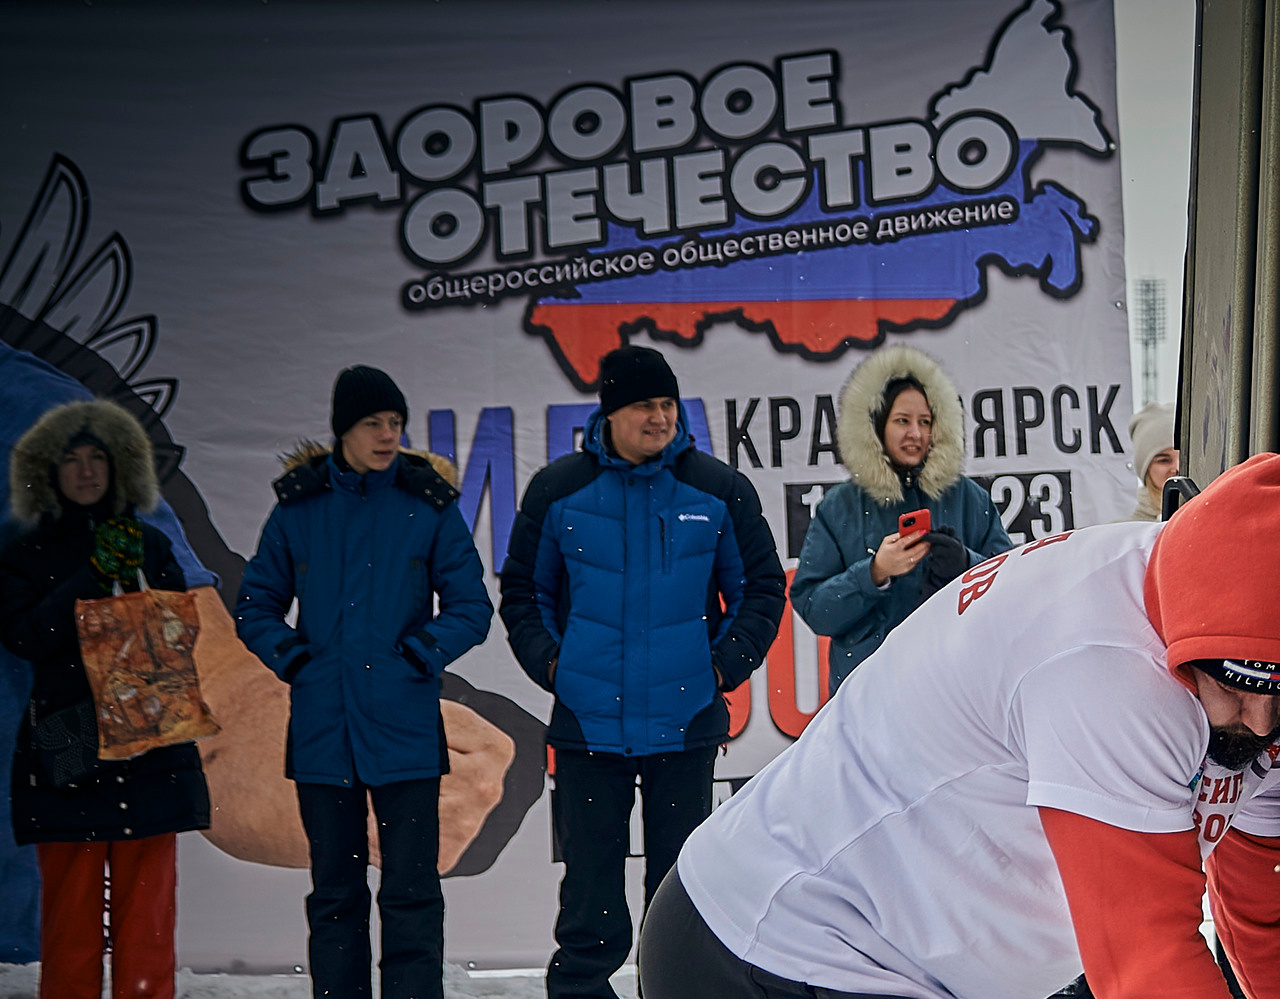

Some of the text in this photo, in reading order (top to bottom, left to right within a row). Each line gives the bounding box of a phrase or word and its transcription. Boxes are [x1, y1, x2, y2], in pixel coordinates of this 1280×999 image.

[244, 51, 838, 211] ЗДОРОВОЕ
[403, 115, 1014, 264] ОТЕЧЕСТВО
[407, 200, 1015, 302] общероссийское общественное движение
[726, 384, 1124, 469] КРАЯРСК
